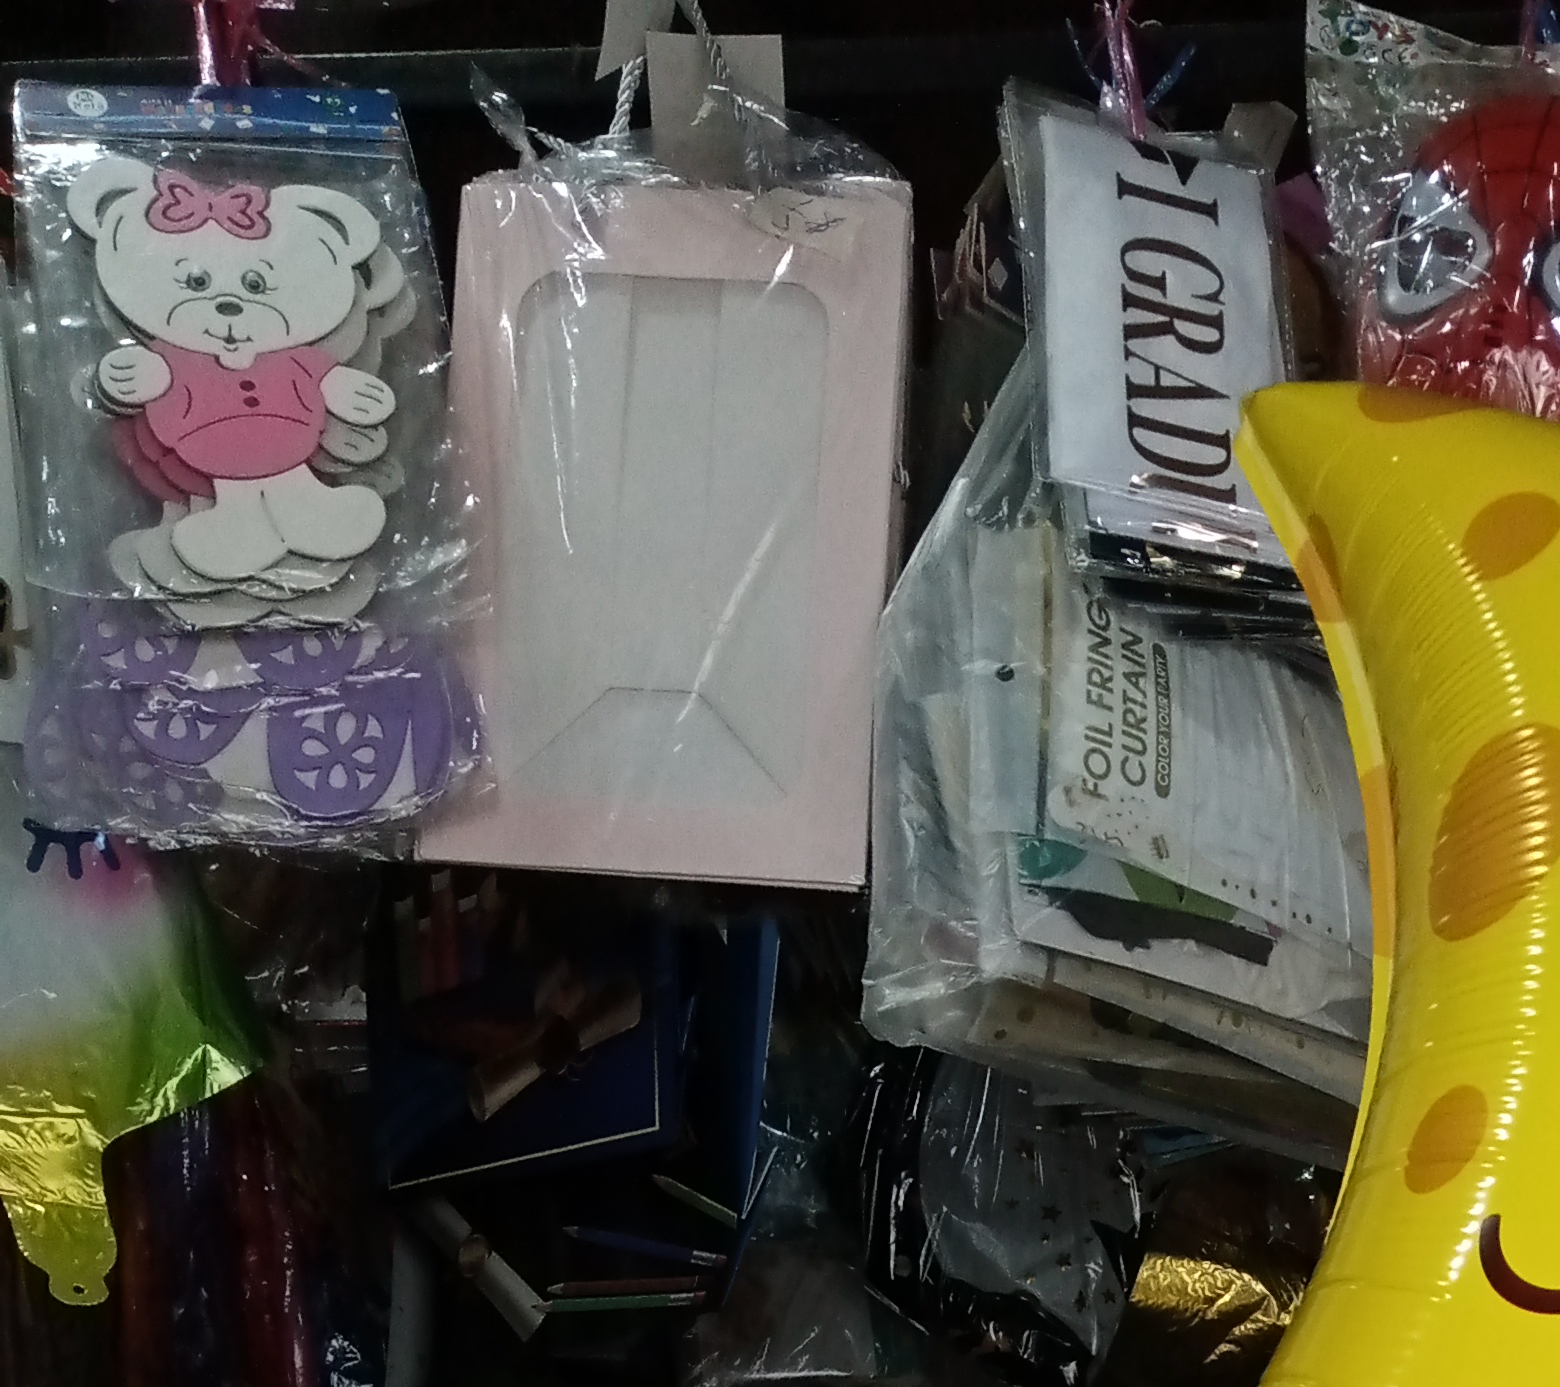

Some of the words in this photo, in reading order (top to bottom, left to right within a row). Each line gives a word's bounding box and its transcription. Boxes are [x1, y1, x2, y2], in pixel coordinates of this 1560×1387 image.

[1083, 582, 1114, 714] FRING
[1119, 626, 1149, 788] CURTAIN
[1156, 696, 1170, 734] YOUR
[1082, 721, 1114, 801] FOIL
[1156, 735, 1171, 786] COLOR
